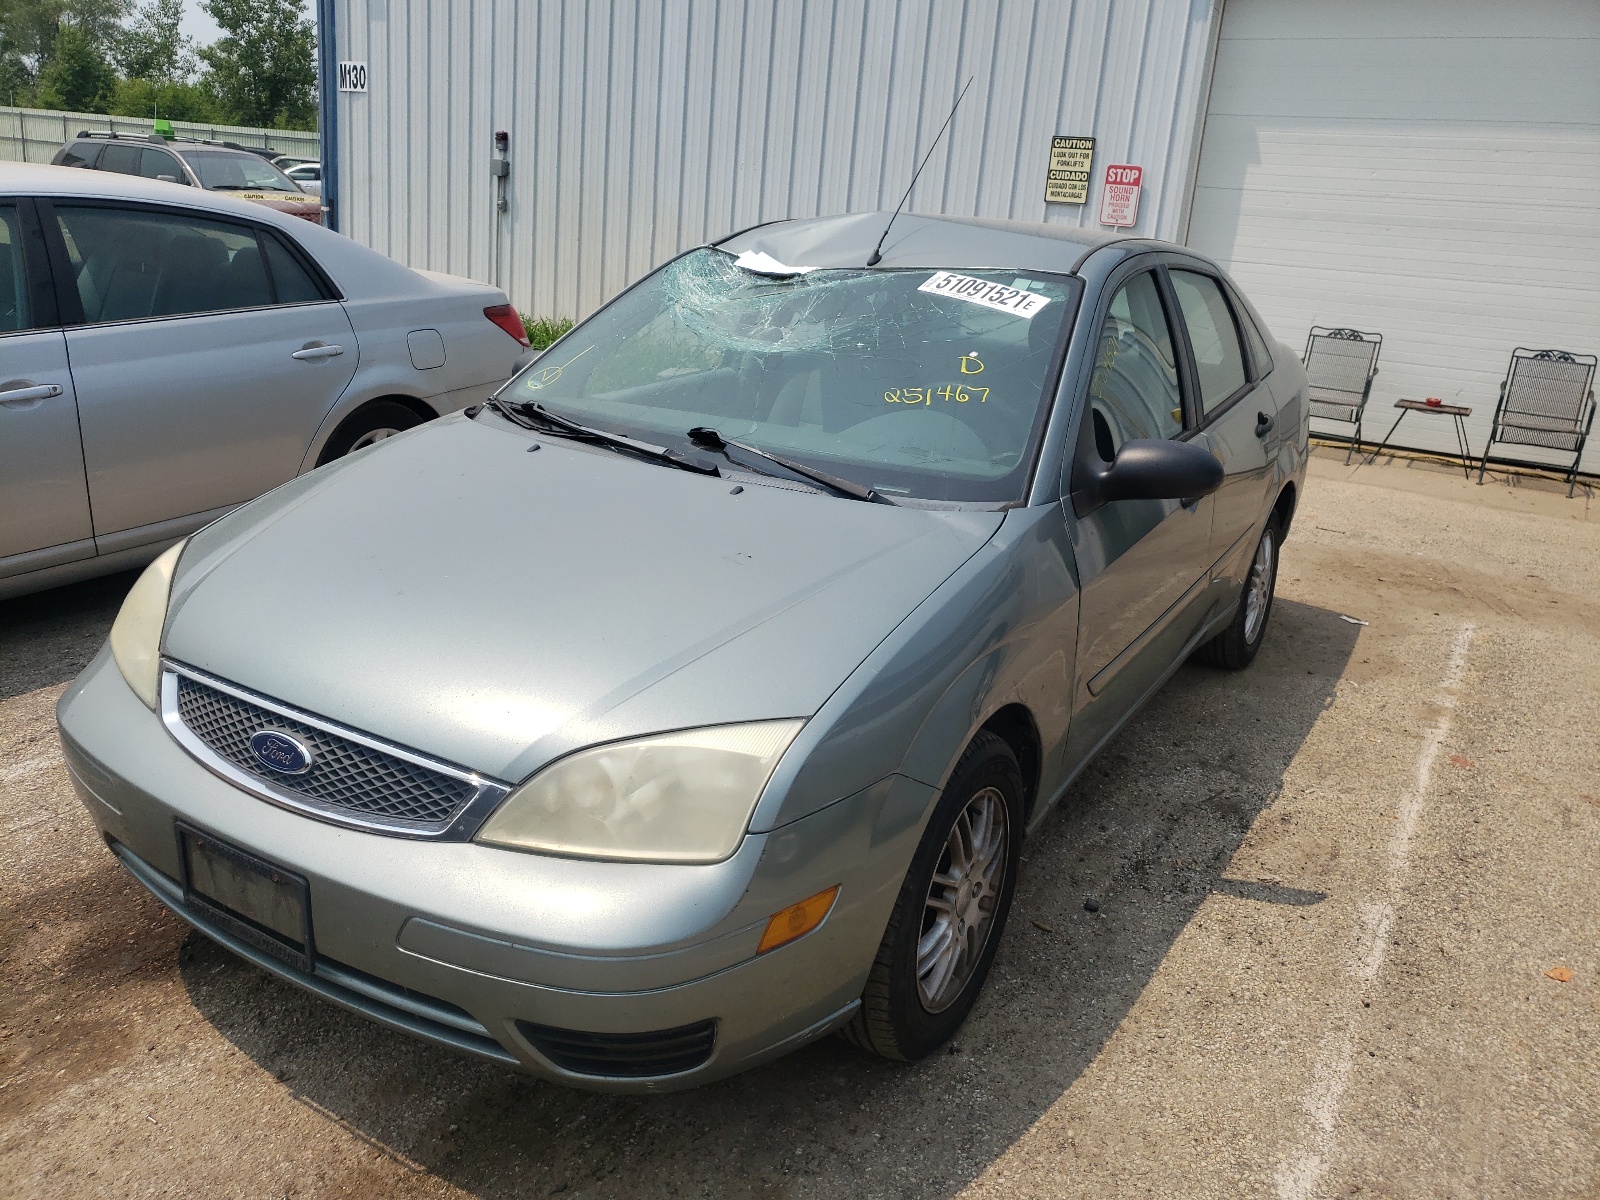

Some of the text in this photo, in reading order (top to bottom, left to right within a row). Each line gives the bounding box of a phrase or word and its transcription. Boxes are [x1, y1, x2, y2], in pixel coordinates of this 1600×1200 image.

[340, 64, 366, 89] M130
[1054, 139, 1092, 149] CAUTION
[1050, 170, 1088, 180] CUIDADO
[1108, 168, 1139, 183] STOP
[1048, 182, 1067, 190] CUIDADO
[1078, 183, 1087, 191] LOS
[1109, 186, 1134, 194] SOUND
[1110, 194, 1130, 202] HORN
[262, 738, 294, 765] Ford
